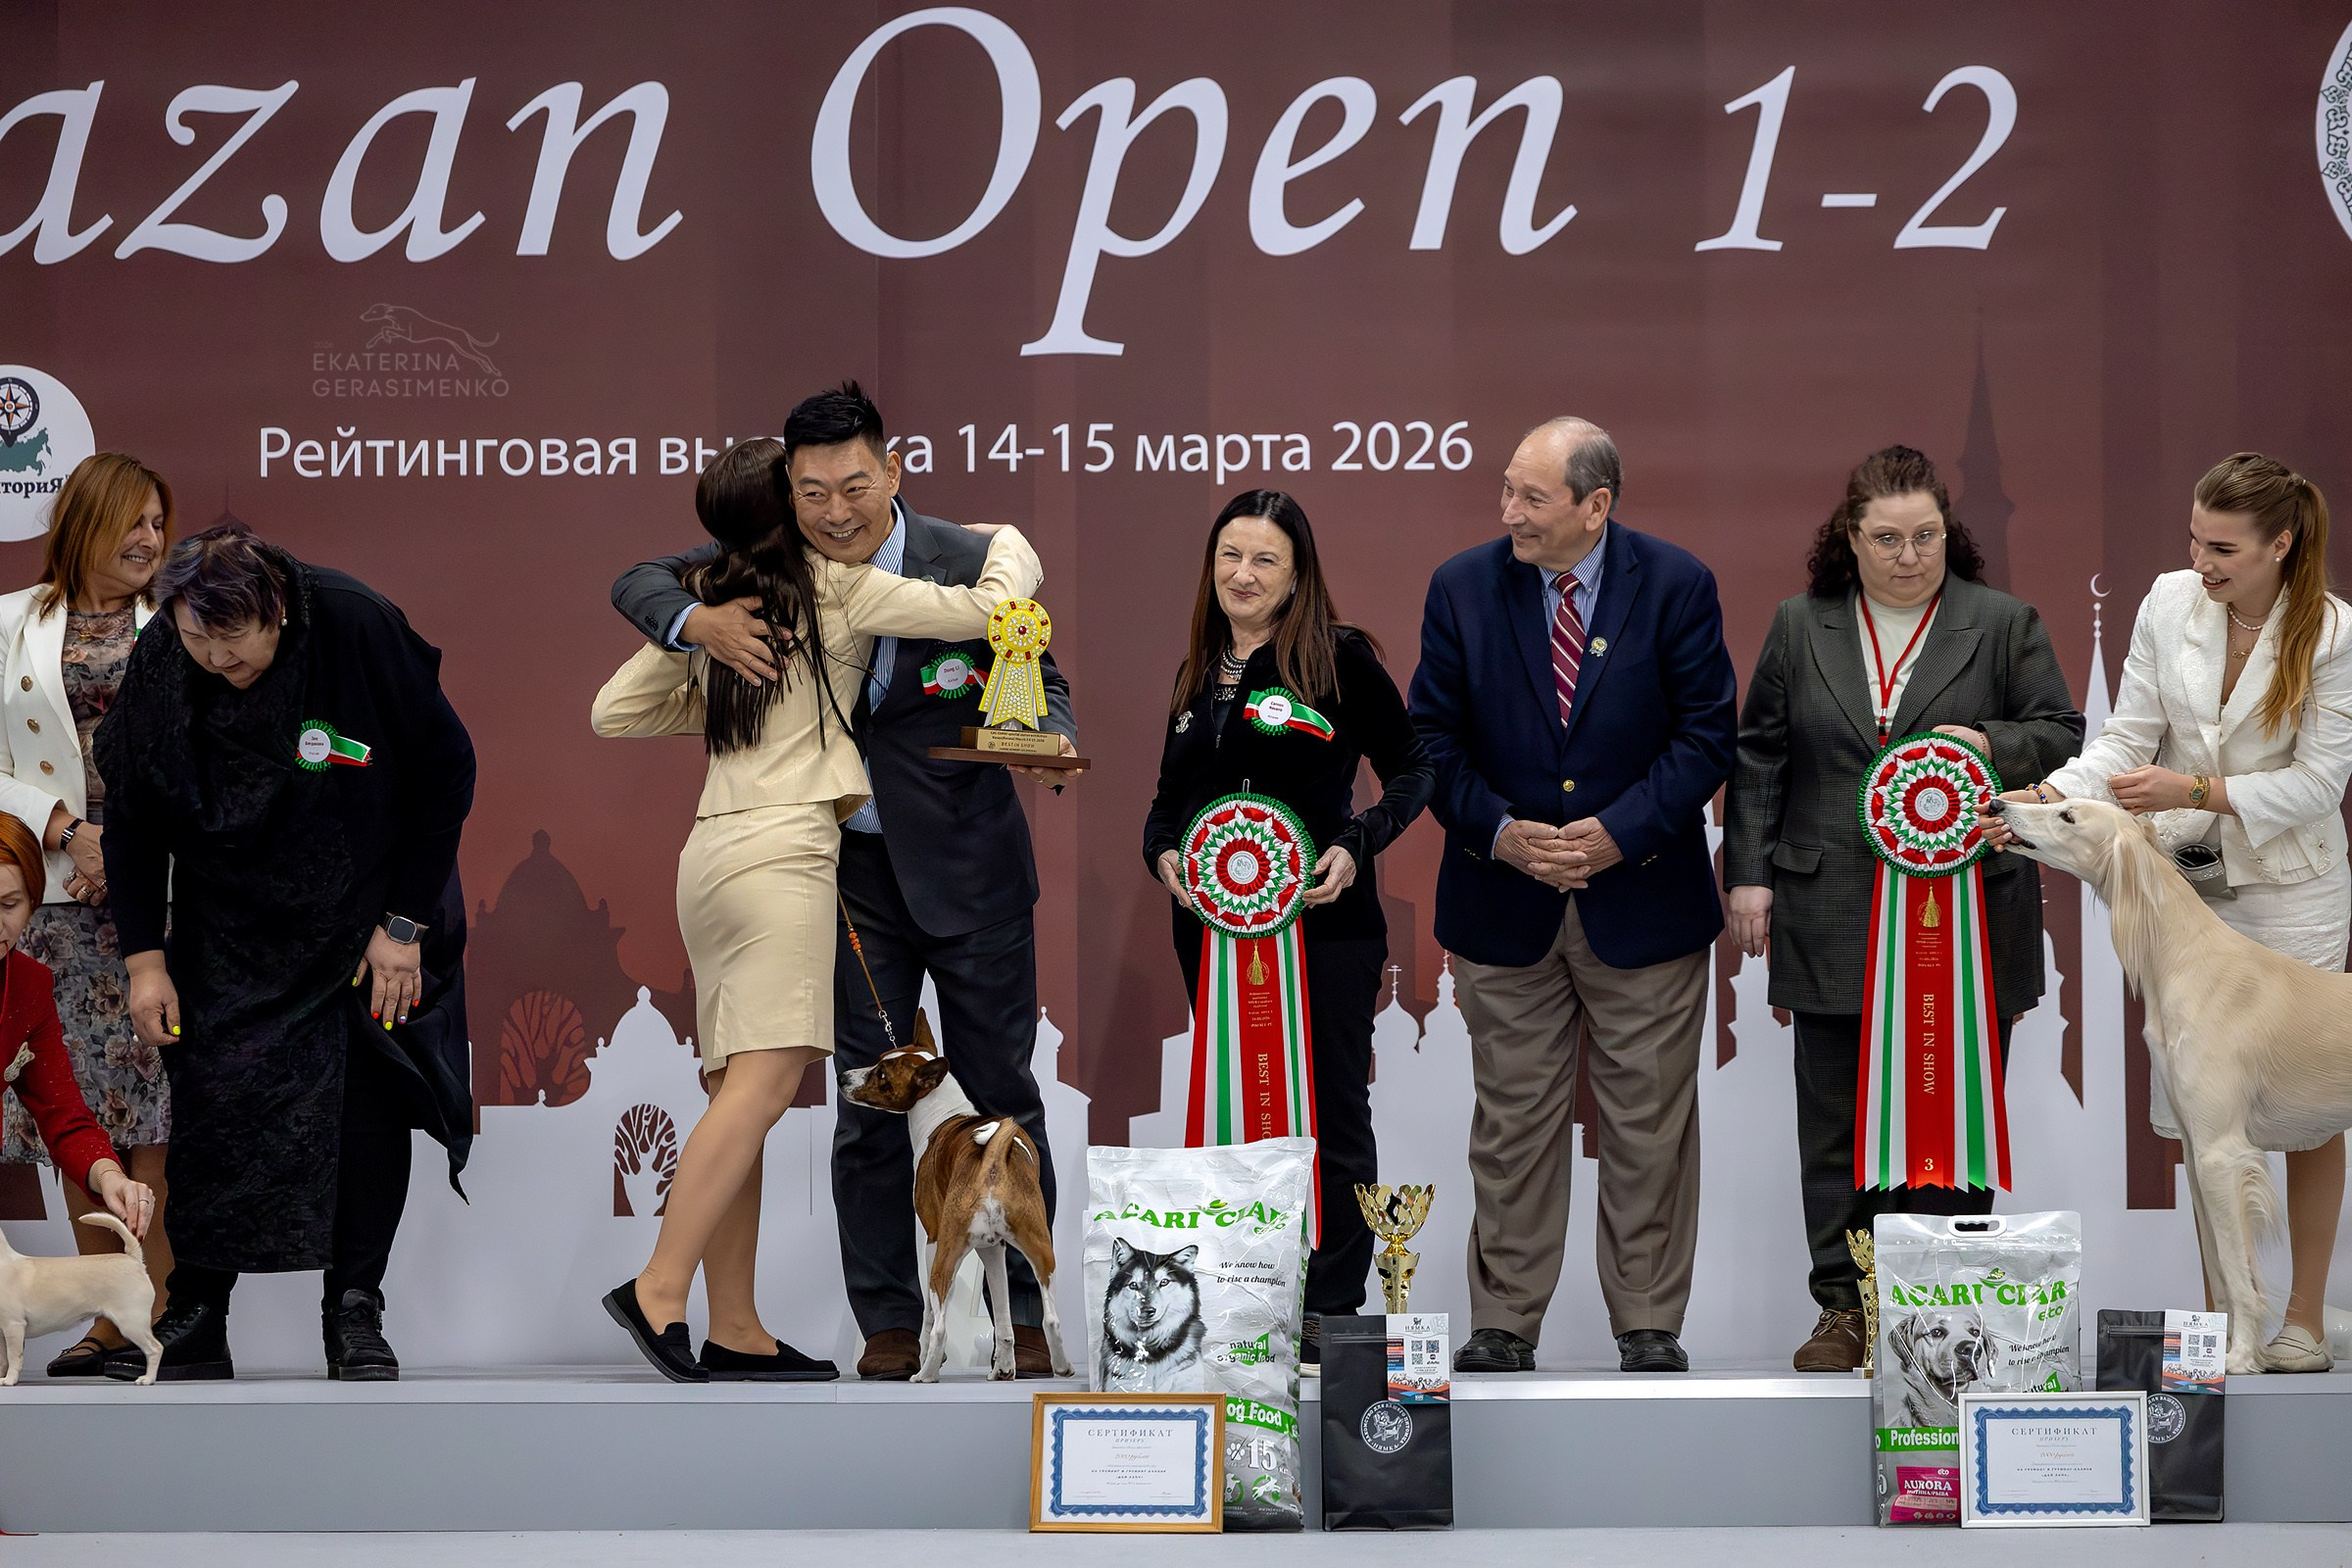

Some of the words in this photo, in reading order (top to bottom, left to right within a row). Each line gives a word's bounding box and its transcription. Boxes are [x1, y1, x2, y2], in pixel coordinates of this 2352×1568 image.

[0, 77, 683, 265] azan
[811, 7, 1578, 357] Open
[1694, 65, 2018, 252] 1-2
[260, 426, 637, 478] Рейтинговая
[957, 423, 1114, 472] 14-15
[1135, 433, 1311, 485] марта
[1331, 420, 1473, 471] 2026
[0, 477, 64, 499] ториЯ
[1923, 993, 1935, 1026] BEST
[1923, 1032, 1935, 1047] IN
[1257, 1053, 1269, 1086] BEST
[1923, 1053, 1935, 1095] SHOW
[1259, 1092, 1271, 1107] IN
[1260, 1112, 1272, 1140] SHO
[1924, 1157, 1935, 1172] 3
[1258, 1260, 1276, 1270] how
[1250, 1275, 1286, 1288] champion
[1888, 1284, 1984, 1306] ACARI
[1996, 1280, 2068, 1306] CIAR
[1229, 1340, 1267, 1350] natural
[2022, 1379, 2057, 1393] atural
[1226, 1401, 1246, 1423] og
[1249, 1401, 1283, 1428] Food
[1088, 1429, 1173, 1438] СЕРТИФИКАТ
[1890, 1429, 1959, 1446] Profession
[2011, 1427, 2097, 1436] СЕРТИФИКАТ
[1247, 1437, 1277, 1471] 15
[1903, 1479, 1953, 1491] AURORA
